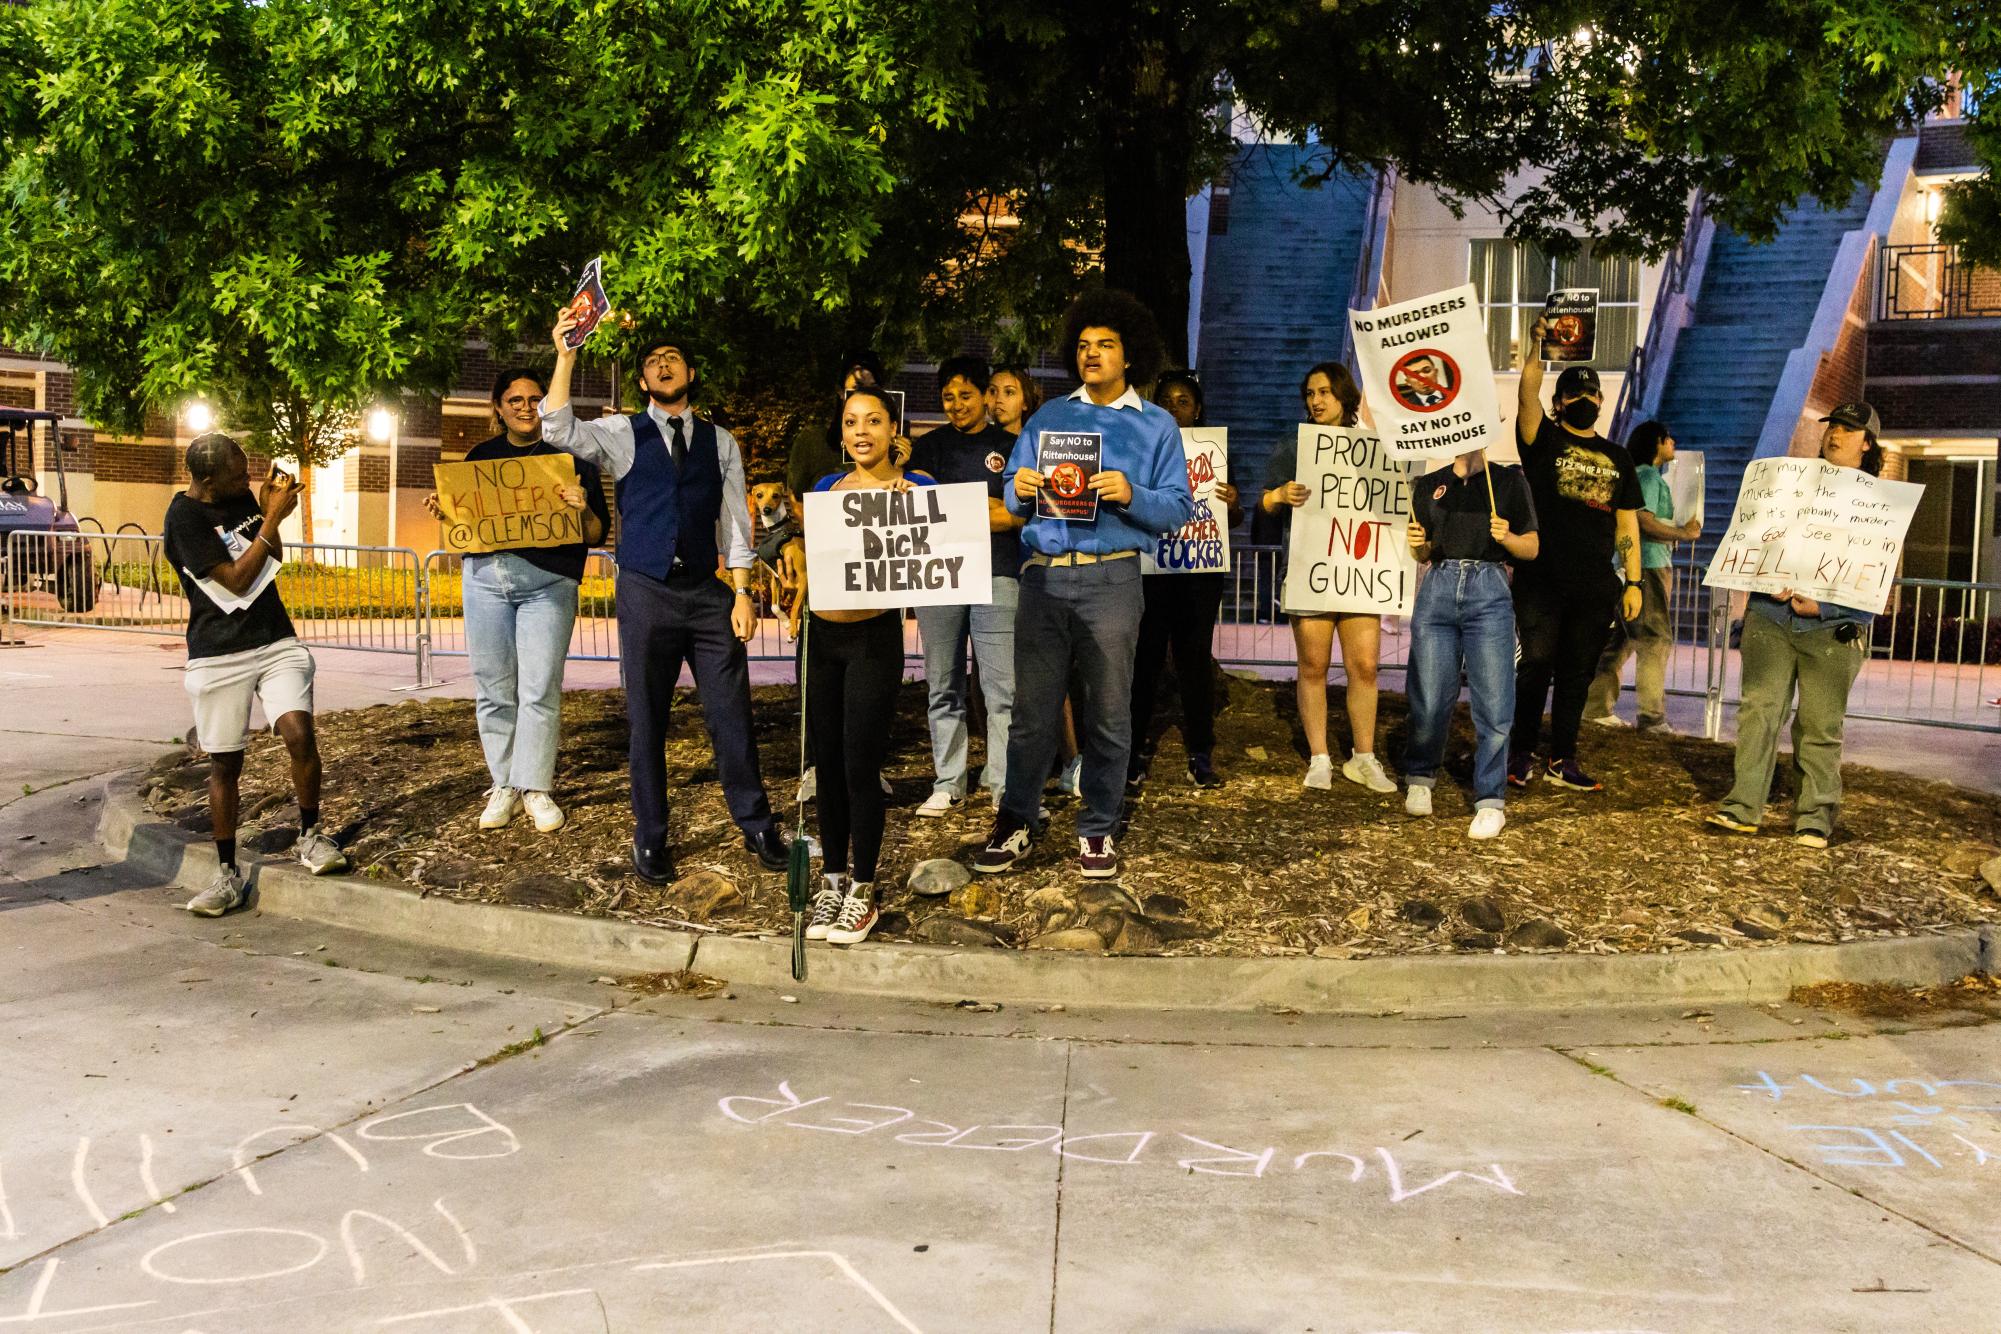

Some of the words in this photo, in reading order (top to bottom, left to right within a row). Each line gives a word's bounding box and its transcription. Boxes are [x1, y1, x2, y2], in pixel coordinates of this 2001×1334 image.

[1547, 305, 1594, 314] ittenhouse!
[1566, 293, 1580, 302] NO
[1581, 294, 1590, 302] to
[1354, 319, 1374, 333] NO
[1377, 296, 1467, 331] MURDERERS
[1380, 321, 1450, 350] ALLOWED
[1395, 424, 1487, 451] RITTENHOUSE
[1401, 420, 1427, 435] SAY
[1431, 417, 1451, 432] NO
[1453, 411, 1472, 426] TO
[1042, 450, 1097, 461] Rittenhouse!
[1049, 436, 1066, 447] Say
[1067, 436, 1081, 446] NO
[1083, 437, 1092, 446] to
[473, 459, 525, 490] NO
[1750, 462, 1768, 483] It
[1777, 463, 1807, 482] may
[1820, 464, 1842, 476] not
[1855, 473, 1874, 489] be
[452, 483, 569, 520] KILLERS
[1321, 473, 1409, 515] PEOPLE
[1792, 490, 1803, 498] to
[1814, 484, 1836, 498] the
[842, 489, 947, 527] SMALL
[1739, 506, 1757, 523] but
[1767, 506, 1786, 519] it's
[1850, 515, 1895, 527] murder
[1328, 516, 1392, 563] NOT
[1730, 529, 1745, 542] to
[1801, 523, 1832, 541] See
[1848, 533, 1872, 547] you
[1882, 537, 1896, 553] in
[1157, 539, 1224, 570] FUCKER
[844, 555, 965, 593] ENERGY
[1309, 562, 1405, 609] GUNS!
[717, 1080, 1527, 1202] MURDERER
